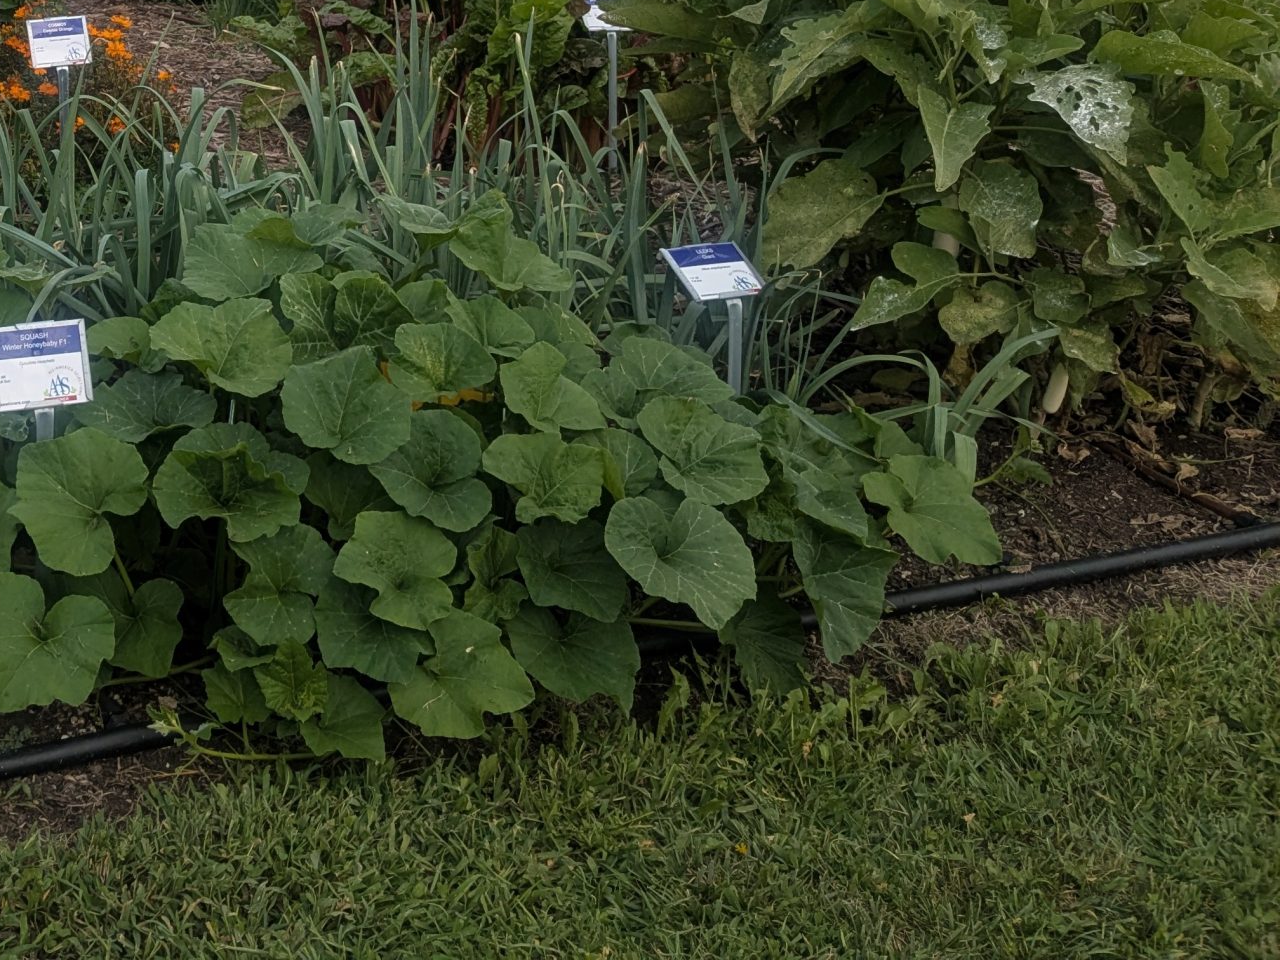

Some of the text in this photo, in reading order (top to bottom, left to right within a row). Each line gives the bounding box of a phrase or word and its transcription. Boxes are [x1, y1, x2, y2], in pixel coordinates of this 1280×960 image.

[20, 332, 49, 341] SQUASH
[1, 338, 67, 352] Winter Honeybaby F1
[49, 374, 71, 397] AAS
